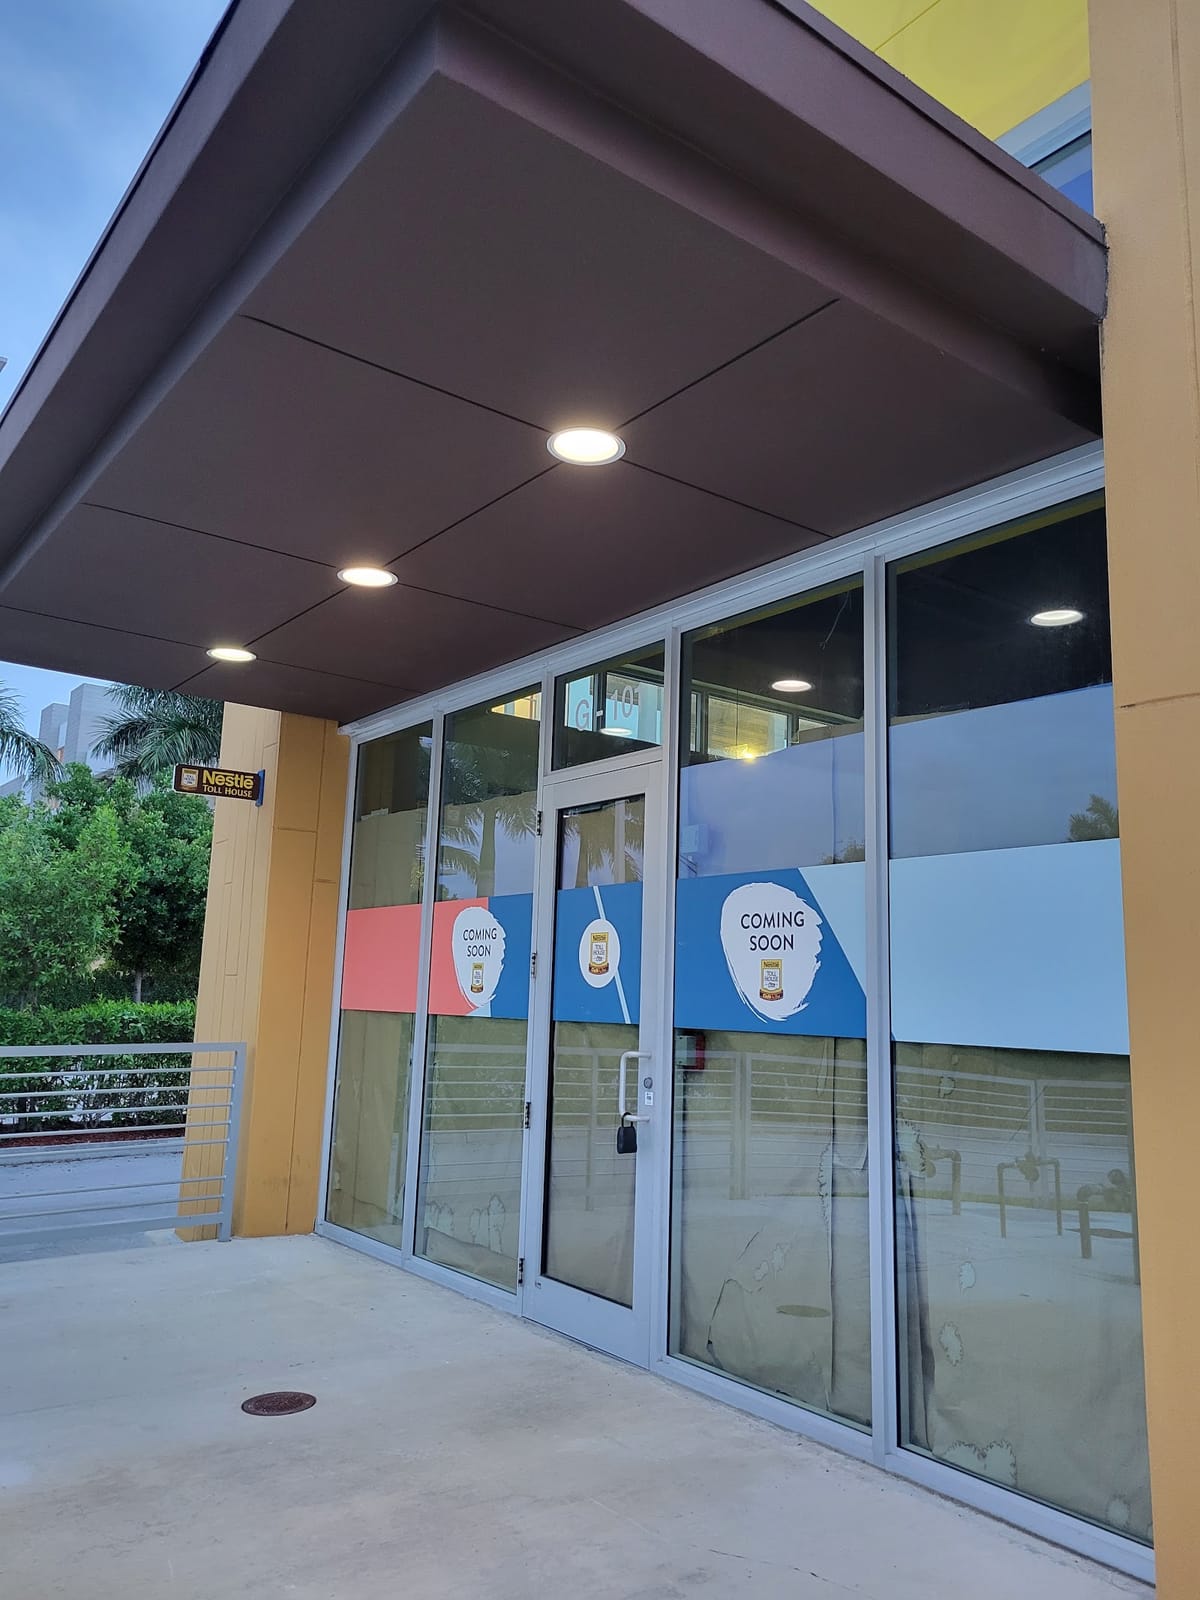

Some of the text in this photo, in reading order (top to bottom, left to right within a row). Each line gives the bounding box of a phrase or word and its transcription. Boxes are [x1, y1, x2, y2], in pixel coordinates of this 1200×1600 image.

[202, 784, 253, 798] TOLL HOUSE
[741, 911, 805, 929] COMING
[462, 927, 497, 941] COMING
[749, 934, 794, 951] SOON
[466, 944, 491, 957] SOON
